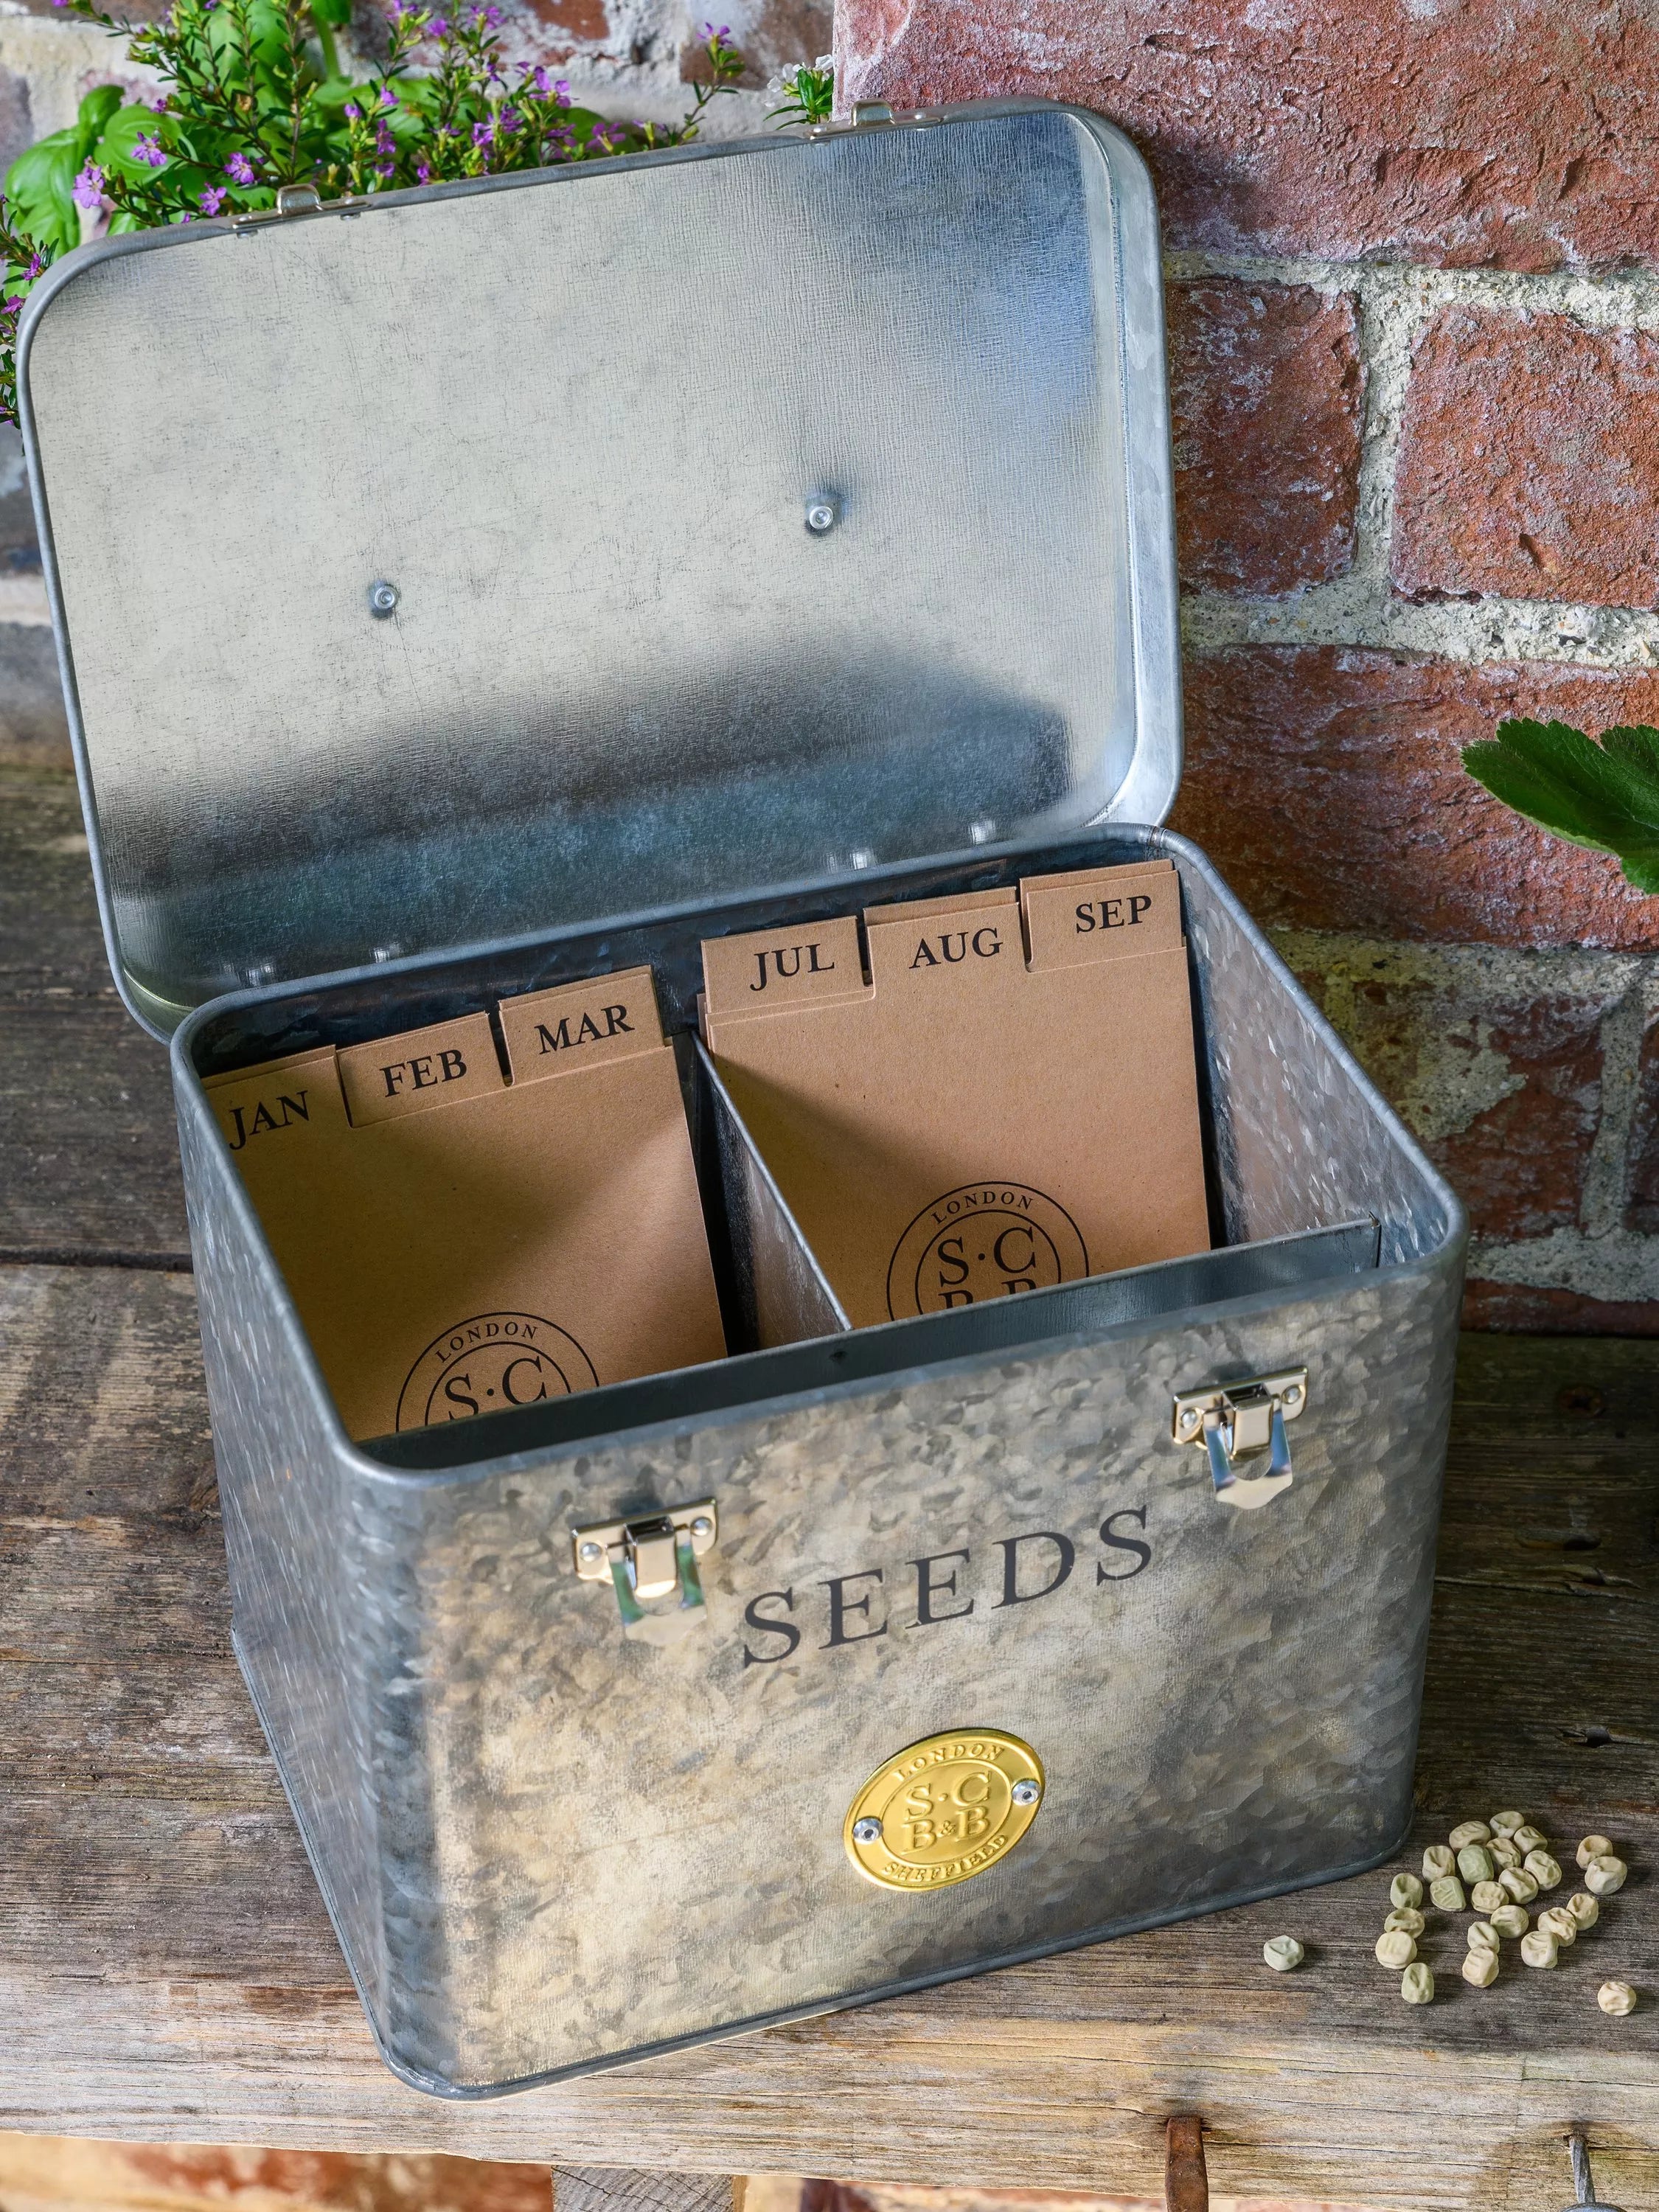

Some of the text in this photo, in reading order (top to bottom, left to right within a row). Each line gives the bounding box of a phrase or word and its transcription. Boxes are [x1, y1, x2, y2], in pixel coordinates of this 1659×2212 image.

[1074, 894, 1153, 934] SEP
[749, 943, 835, 992] JUL
[908, 927, 1004, 970] AUG
[534, 1004, 636, 1055] MAR
[379, 1048, 468, 1098] FEB
[229, 1090, 310, 1150] JAN
[931, 1190, 1034, 1225] LONDON
[435, 1321, 539, 1363] LONDON
[743, 1504, 1152, 1669] SEEDS
[892, 1742, 1006, 1781] LONDON
[900, 1804, 991, 1857] B&B
[881, 1833, 1009, 1882] SHEFFIELD
